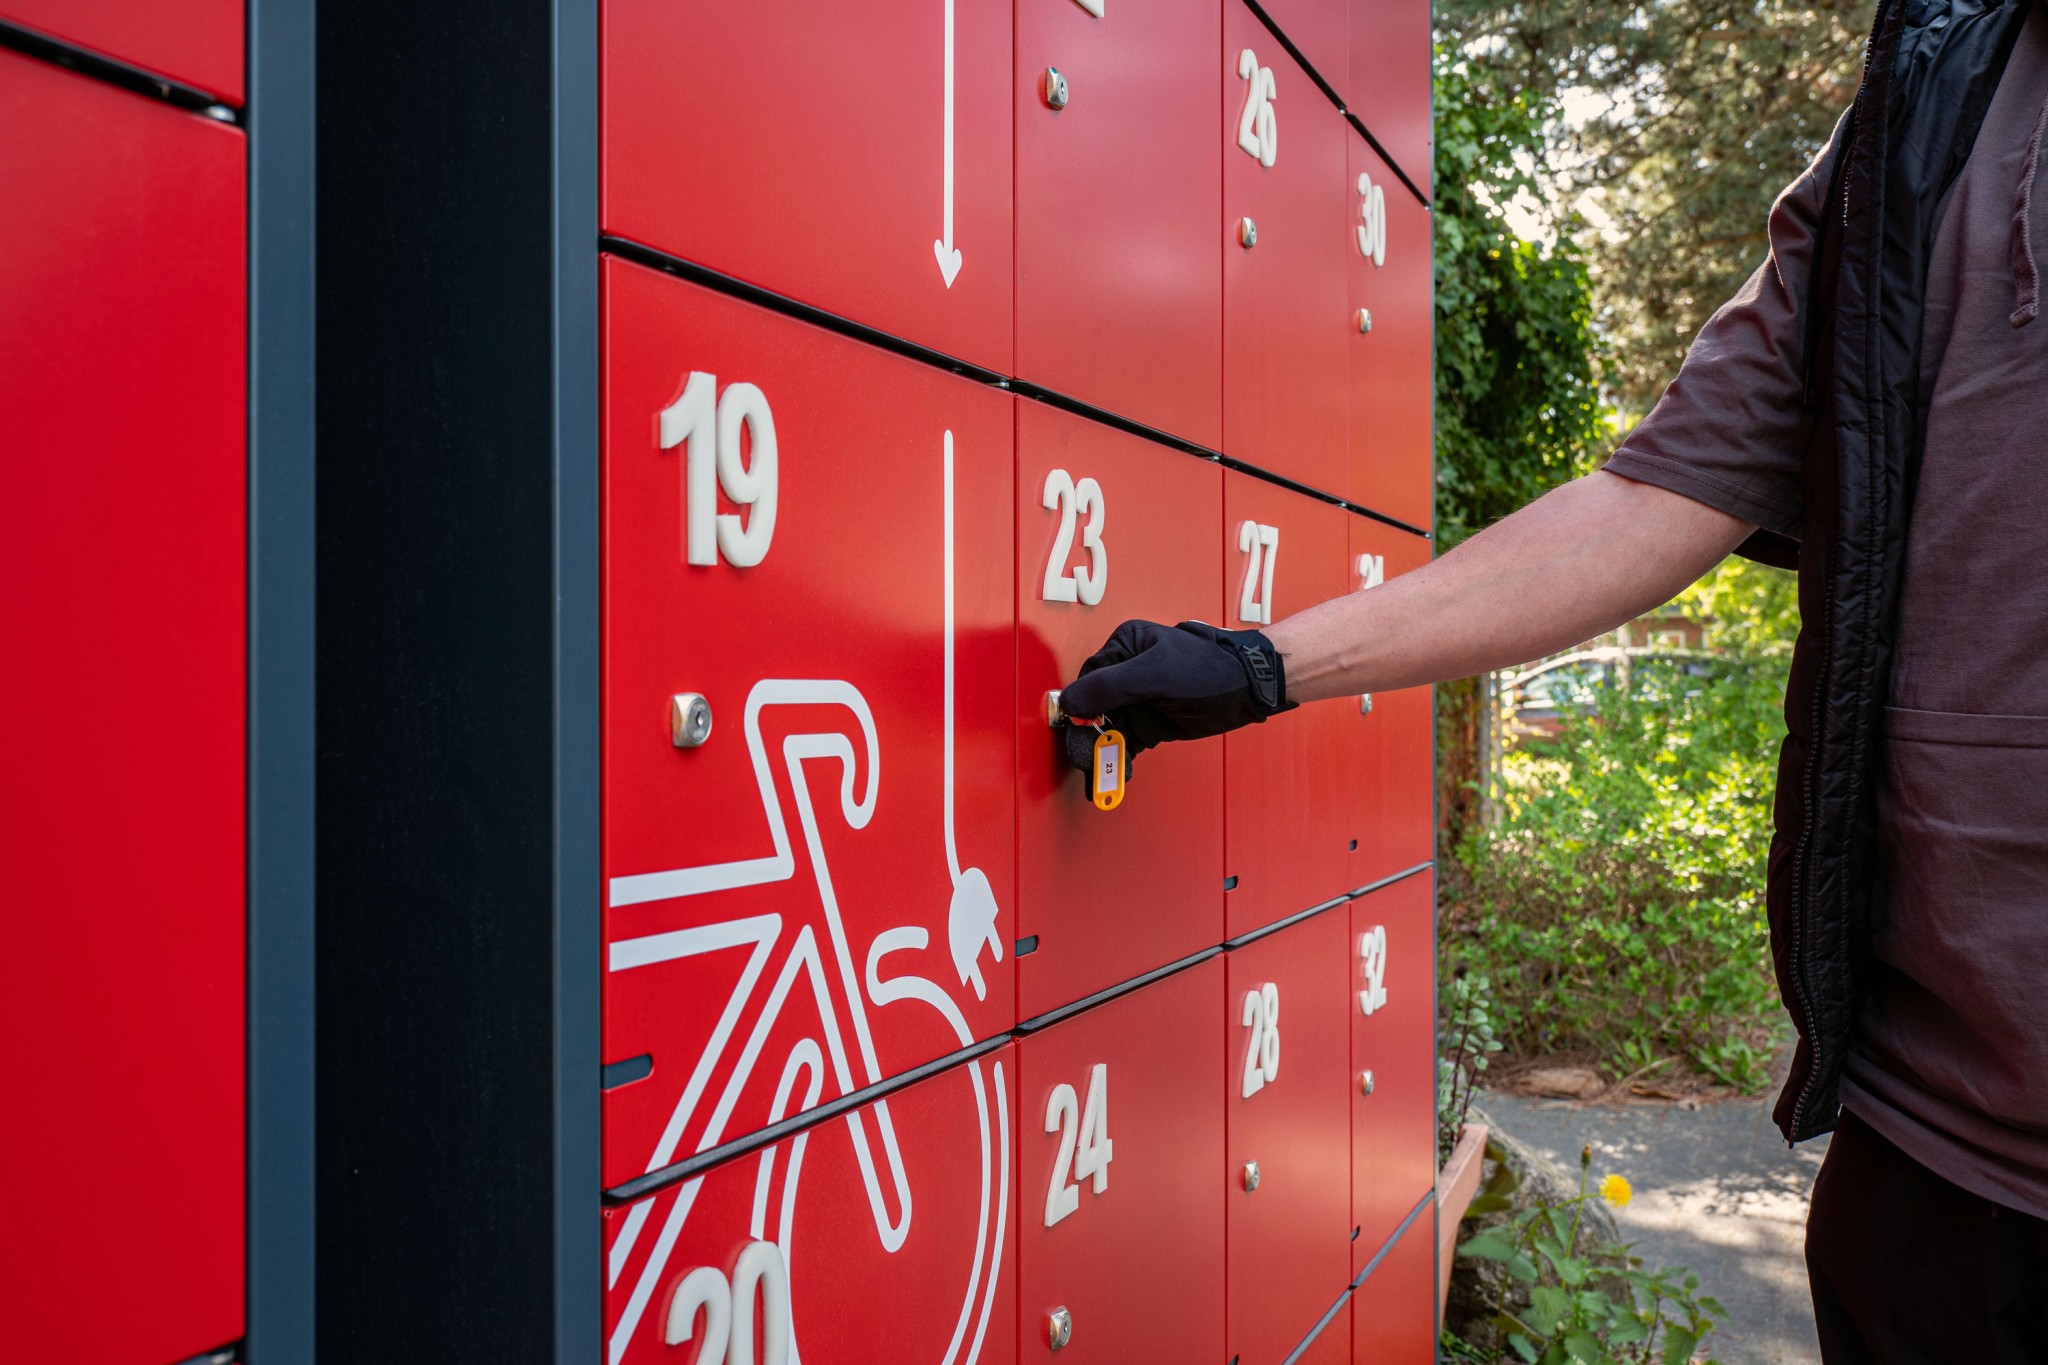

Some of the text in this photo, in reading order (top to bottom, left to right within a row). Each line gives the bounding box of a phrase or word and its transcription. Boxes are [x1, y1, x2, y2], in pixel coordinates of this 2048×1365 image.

[1239, 49, 1277, 167] 26
[1358, 172, 1386, 266] 30
[660, 371, 778, 568] 19
[1043, 469, 1107, 605] 23
[1239, 520, 1278, 624] 27
[1105, 762, 1113, 774] 23
[1360, 925, 1387, 1015] 32
[1242, 982, 1280, 1098] 28
[1044, 1063, 1112, 1227] 24
